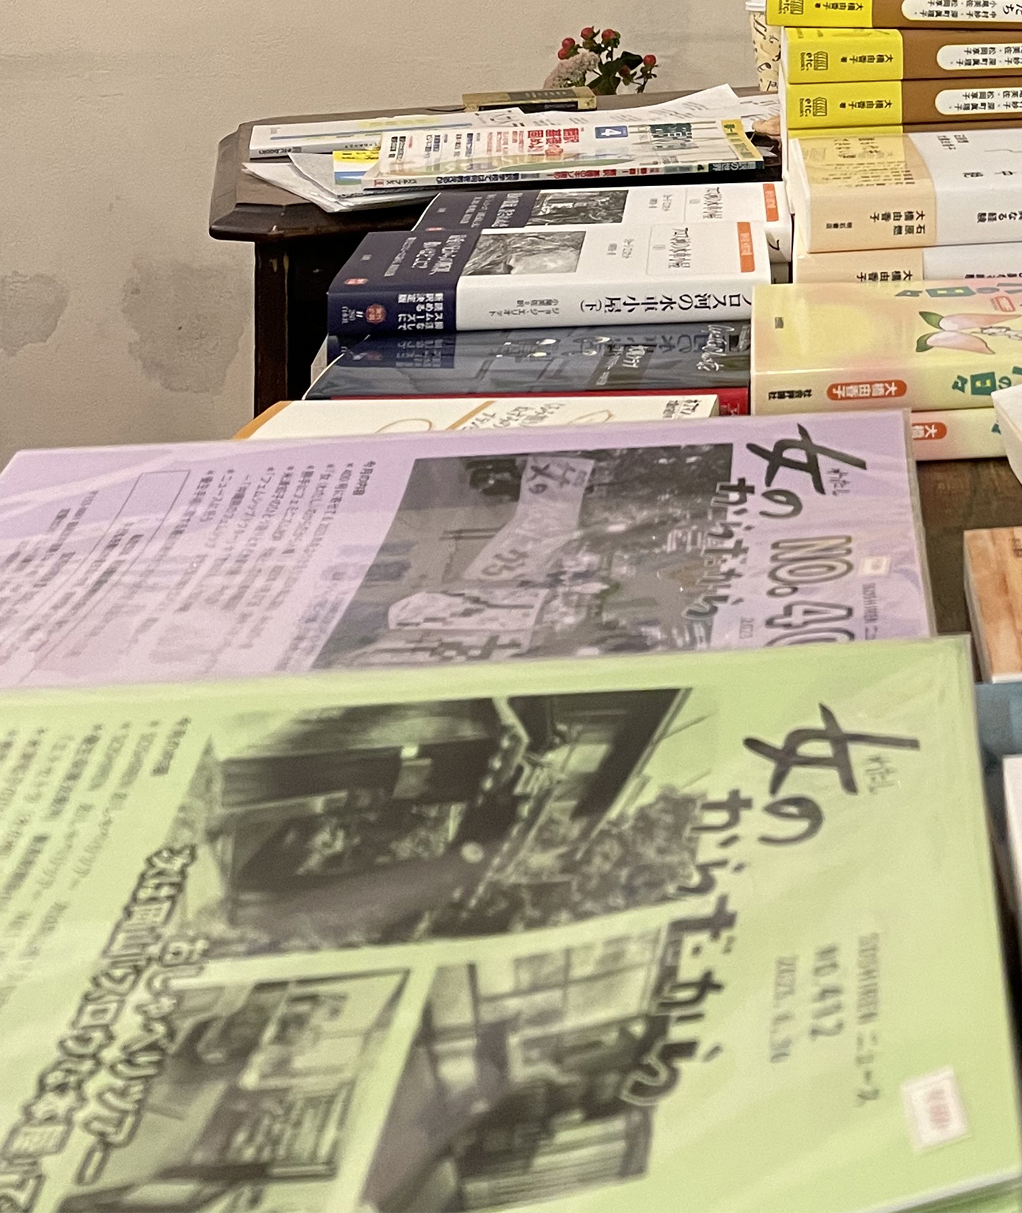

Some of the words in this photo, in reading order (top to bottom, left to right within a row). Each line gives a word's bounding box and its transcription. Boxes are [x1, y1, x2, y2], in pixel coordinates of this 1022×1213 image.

[869, 210, 926, 224] 大橋由香子
[831, 379, 897, 398] 大橋由香子
[619, 789, 754, 1106] からだから
